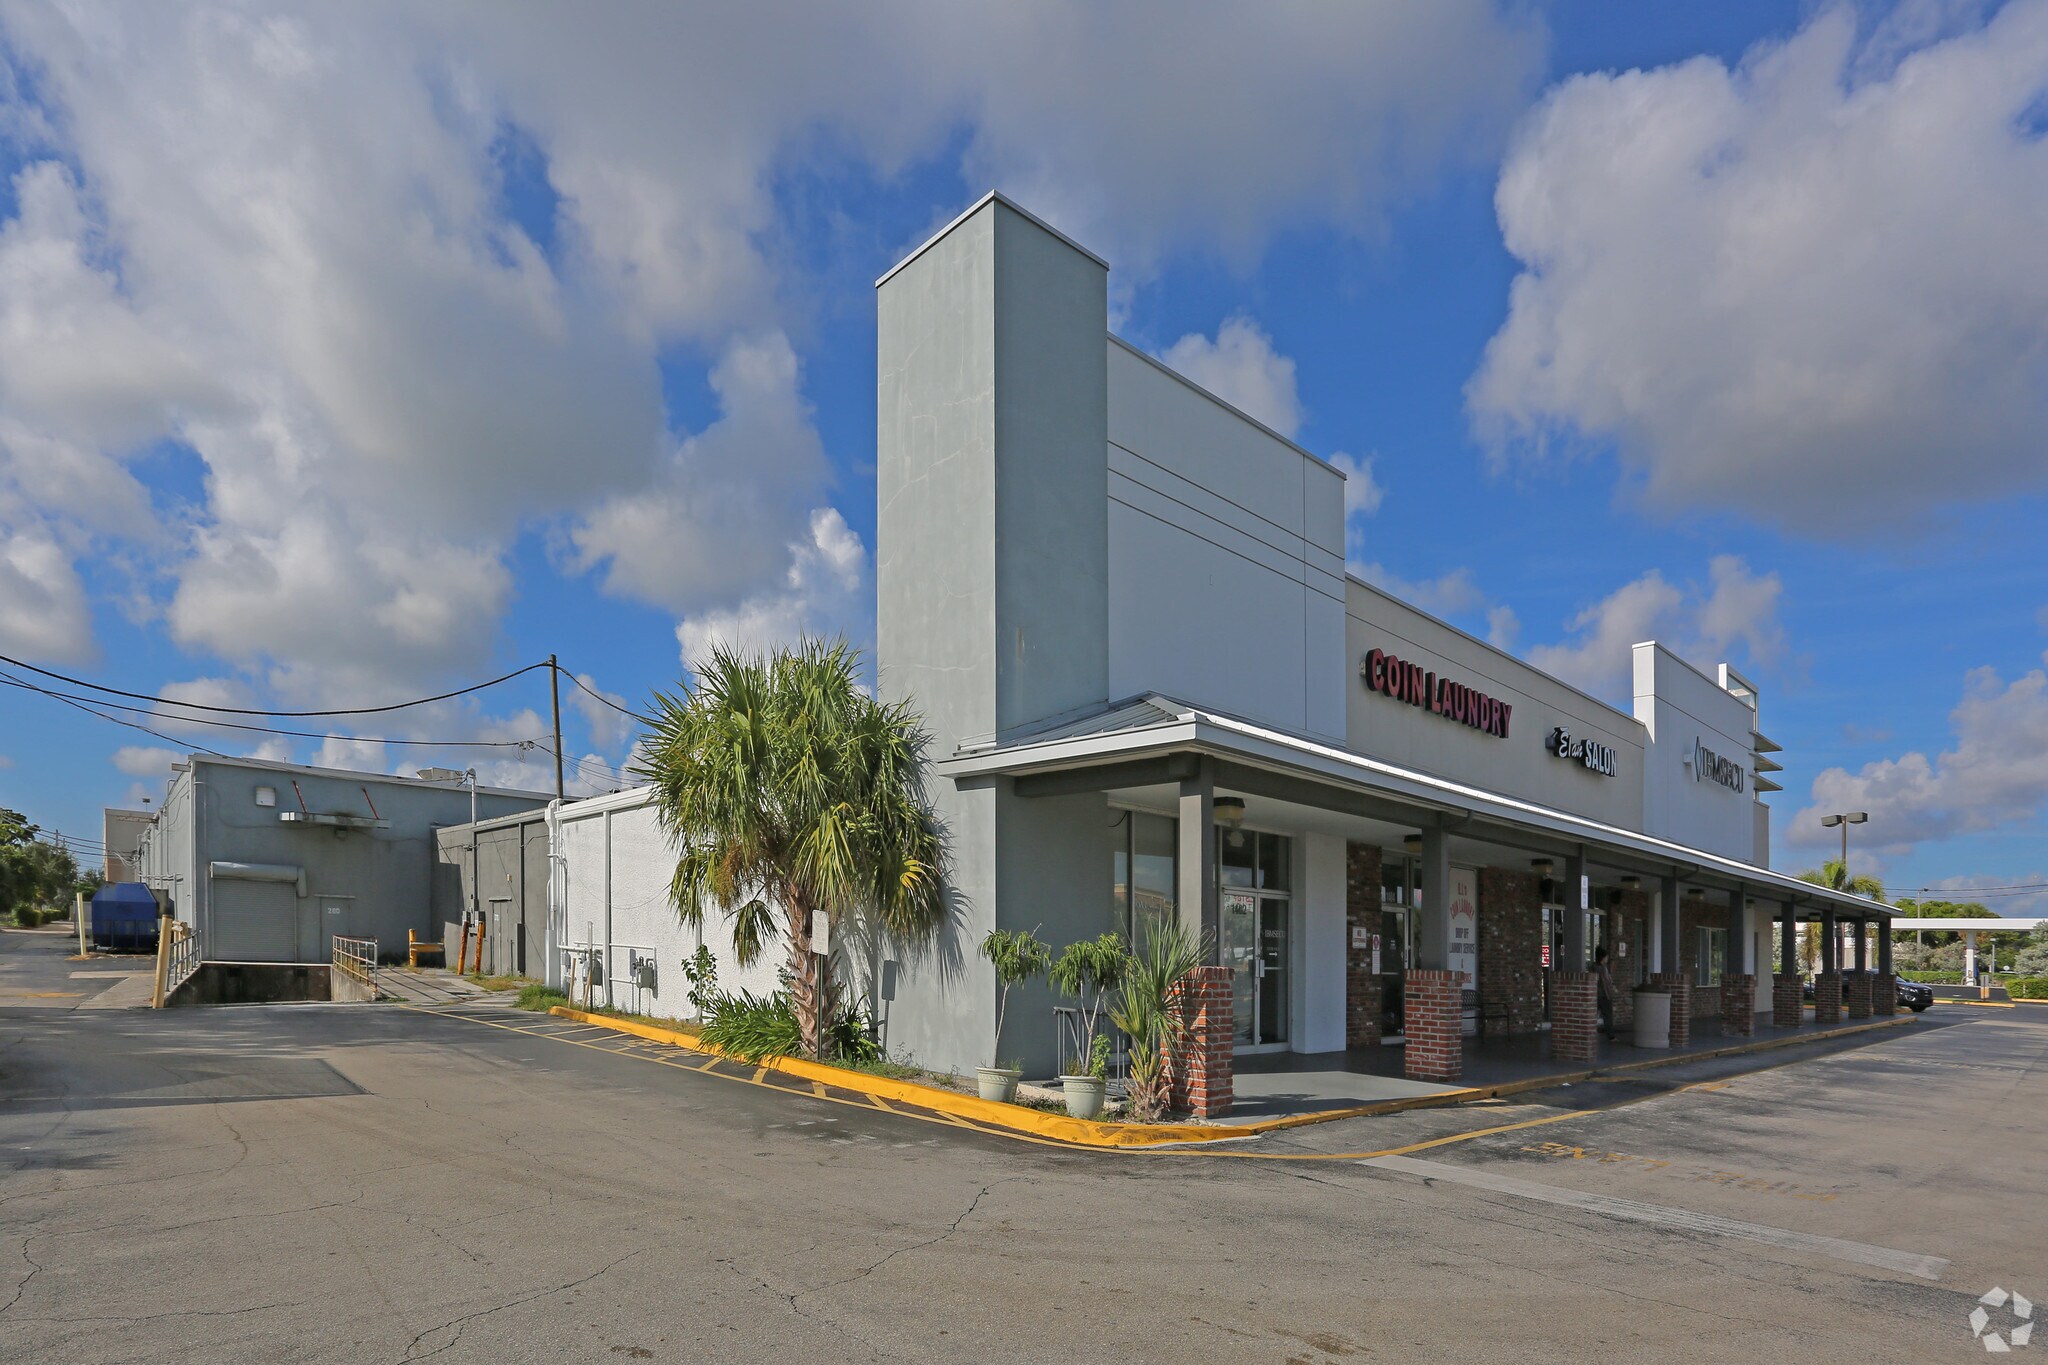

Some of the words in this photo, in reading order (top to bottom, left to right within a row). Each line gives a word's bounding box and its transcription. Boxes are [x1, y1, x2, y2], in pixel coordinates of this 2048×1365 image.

[1366, 647, 1424, 706] COIN
[1425, 671, 1513, 739] LAUNDRY
[1584, 738, 1617, 777] SALON
